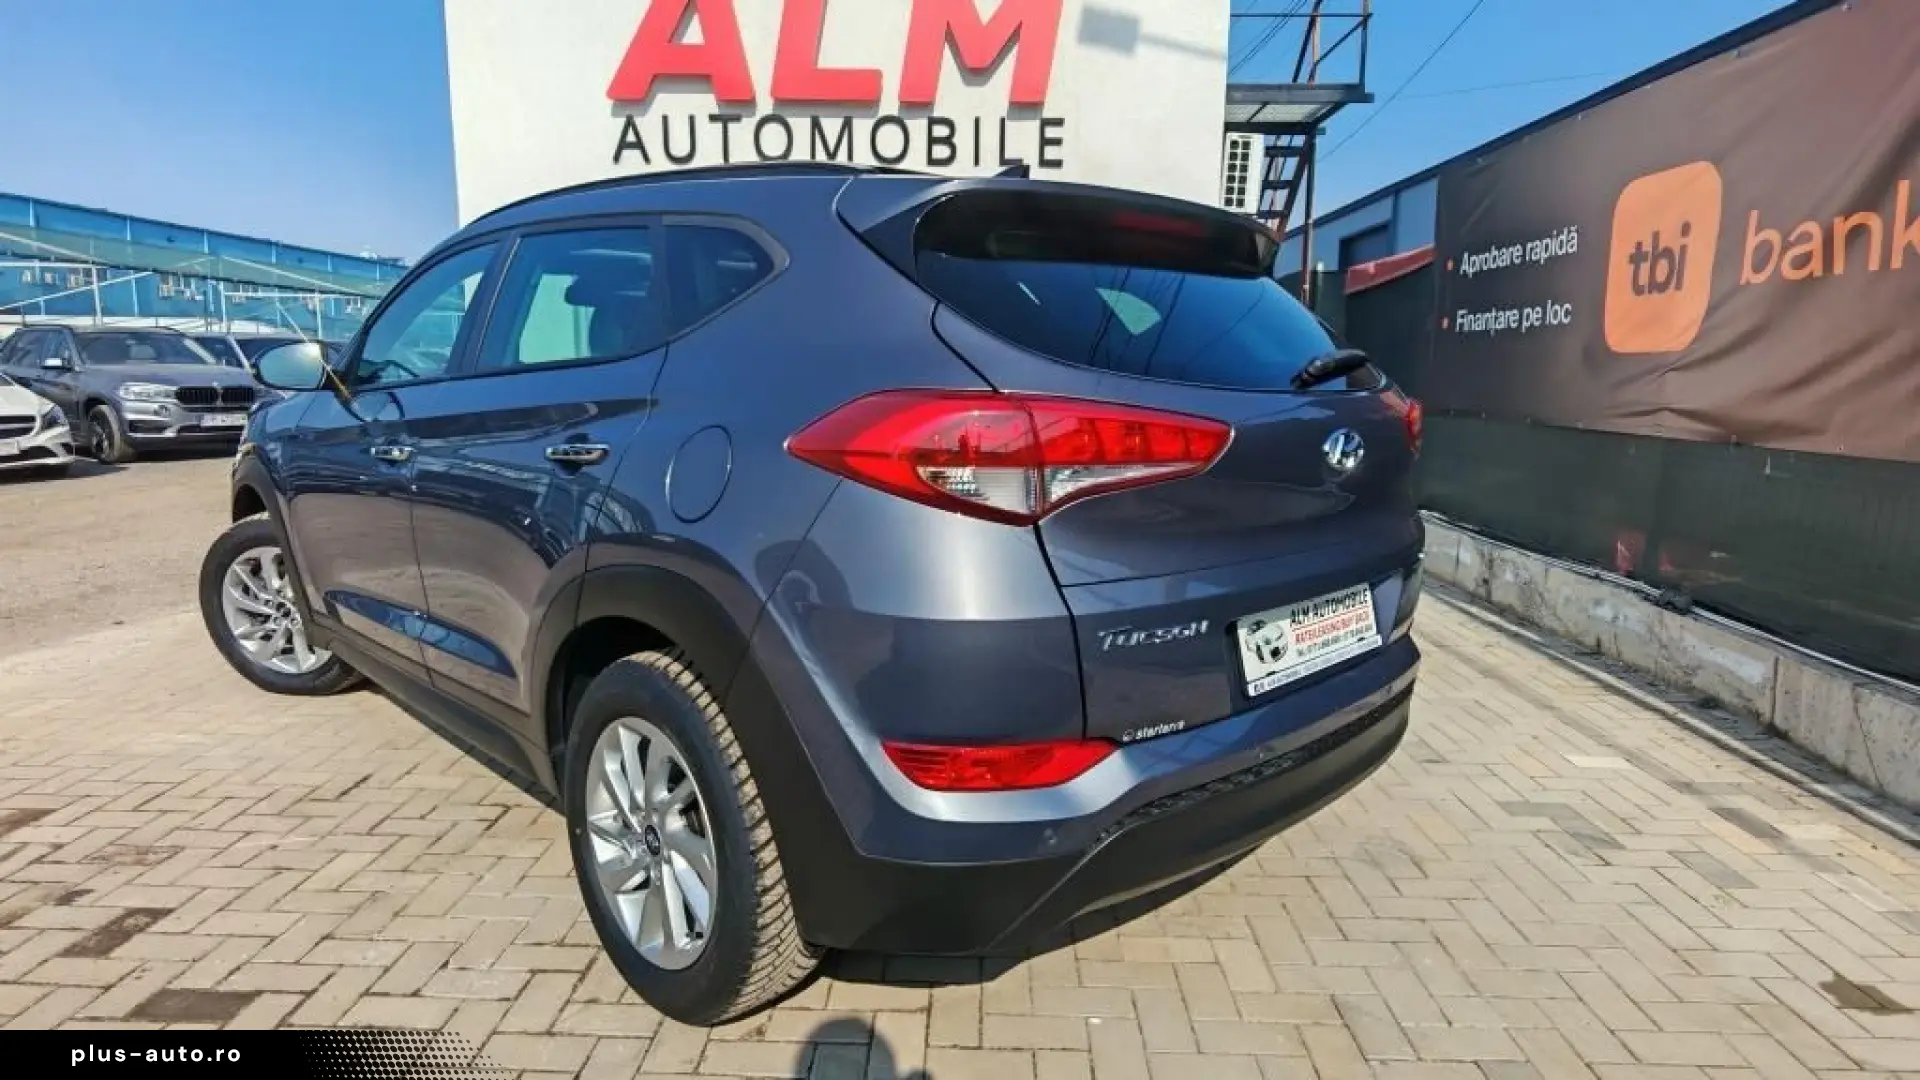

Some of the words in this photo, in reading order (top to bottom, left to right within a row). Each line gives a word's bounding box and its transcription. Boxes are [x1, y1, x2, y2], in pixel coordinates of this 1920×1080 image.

[606, 0, 1062, 105] ALM
[613, 114, 1065, 169] AUTOMOBILE
[1459, 244, 1524, 280] Aprobare
[1525, 225, 1579, 270] rapidă
[1628, 220, 1692, 297] tbi
[1739, 179, 1920, 286] bank
[1521, 306, 1542, 329] pe
[1545, 298, 1572, 326] loc
[1290, 605, 1310, 625] ALM
[1313, 587, 1369, 618] AUTOMOBILE
